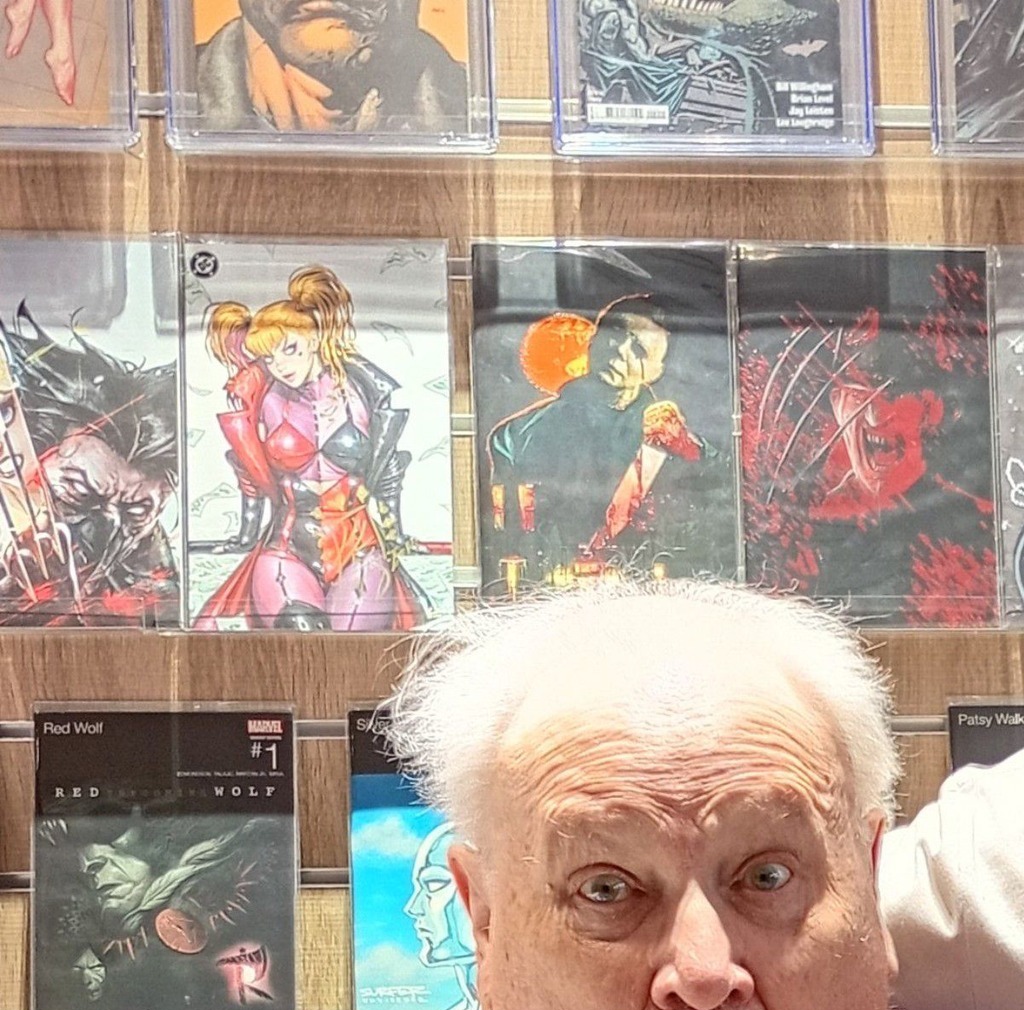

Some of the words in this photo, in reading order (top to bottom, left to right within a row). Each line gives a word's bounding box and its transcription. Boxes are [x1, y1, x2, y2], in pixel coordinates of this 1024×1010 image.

[247, 719, 283, 734] MARVEL
[958, 713, 992, 728] Patsy
[43, 722, 71, 735] Red
[74, 722, 104, 735] Wolf
[251, 741, 278, 770] #1
[55, 786, 100, 798] RED
[214, 786, 277, 797] WOLF
